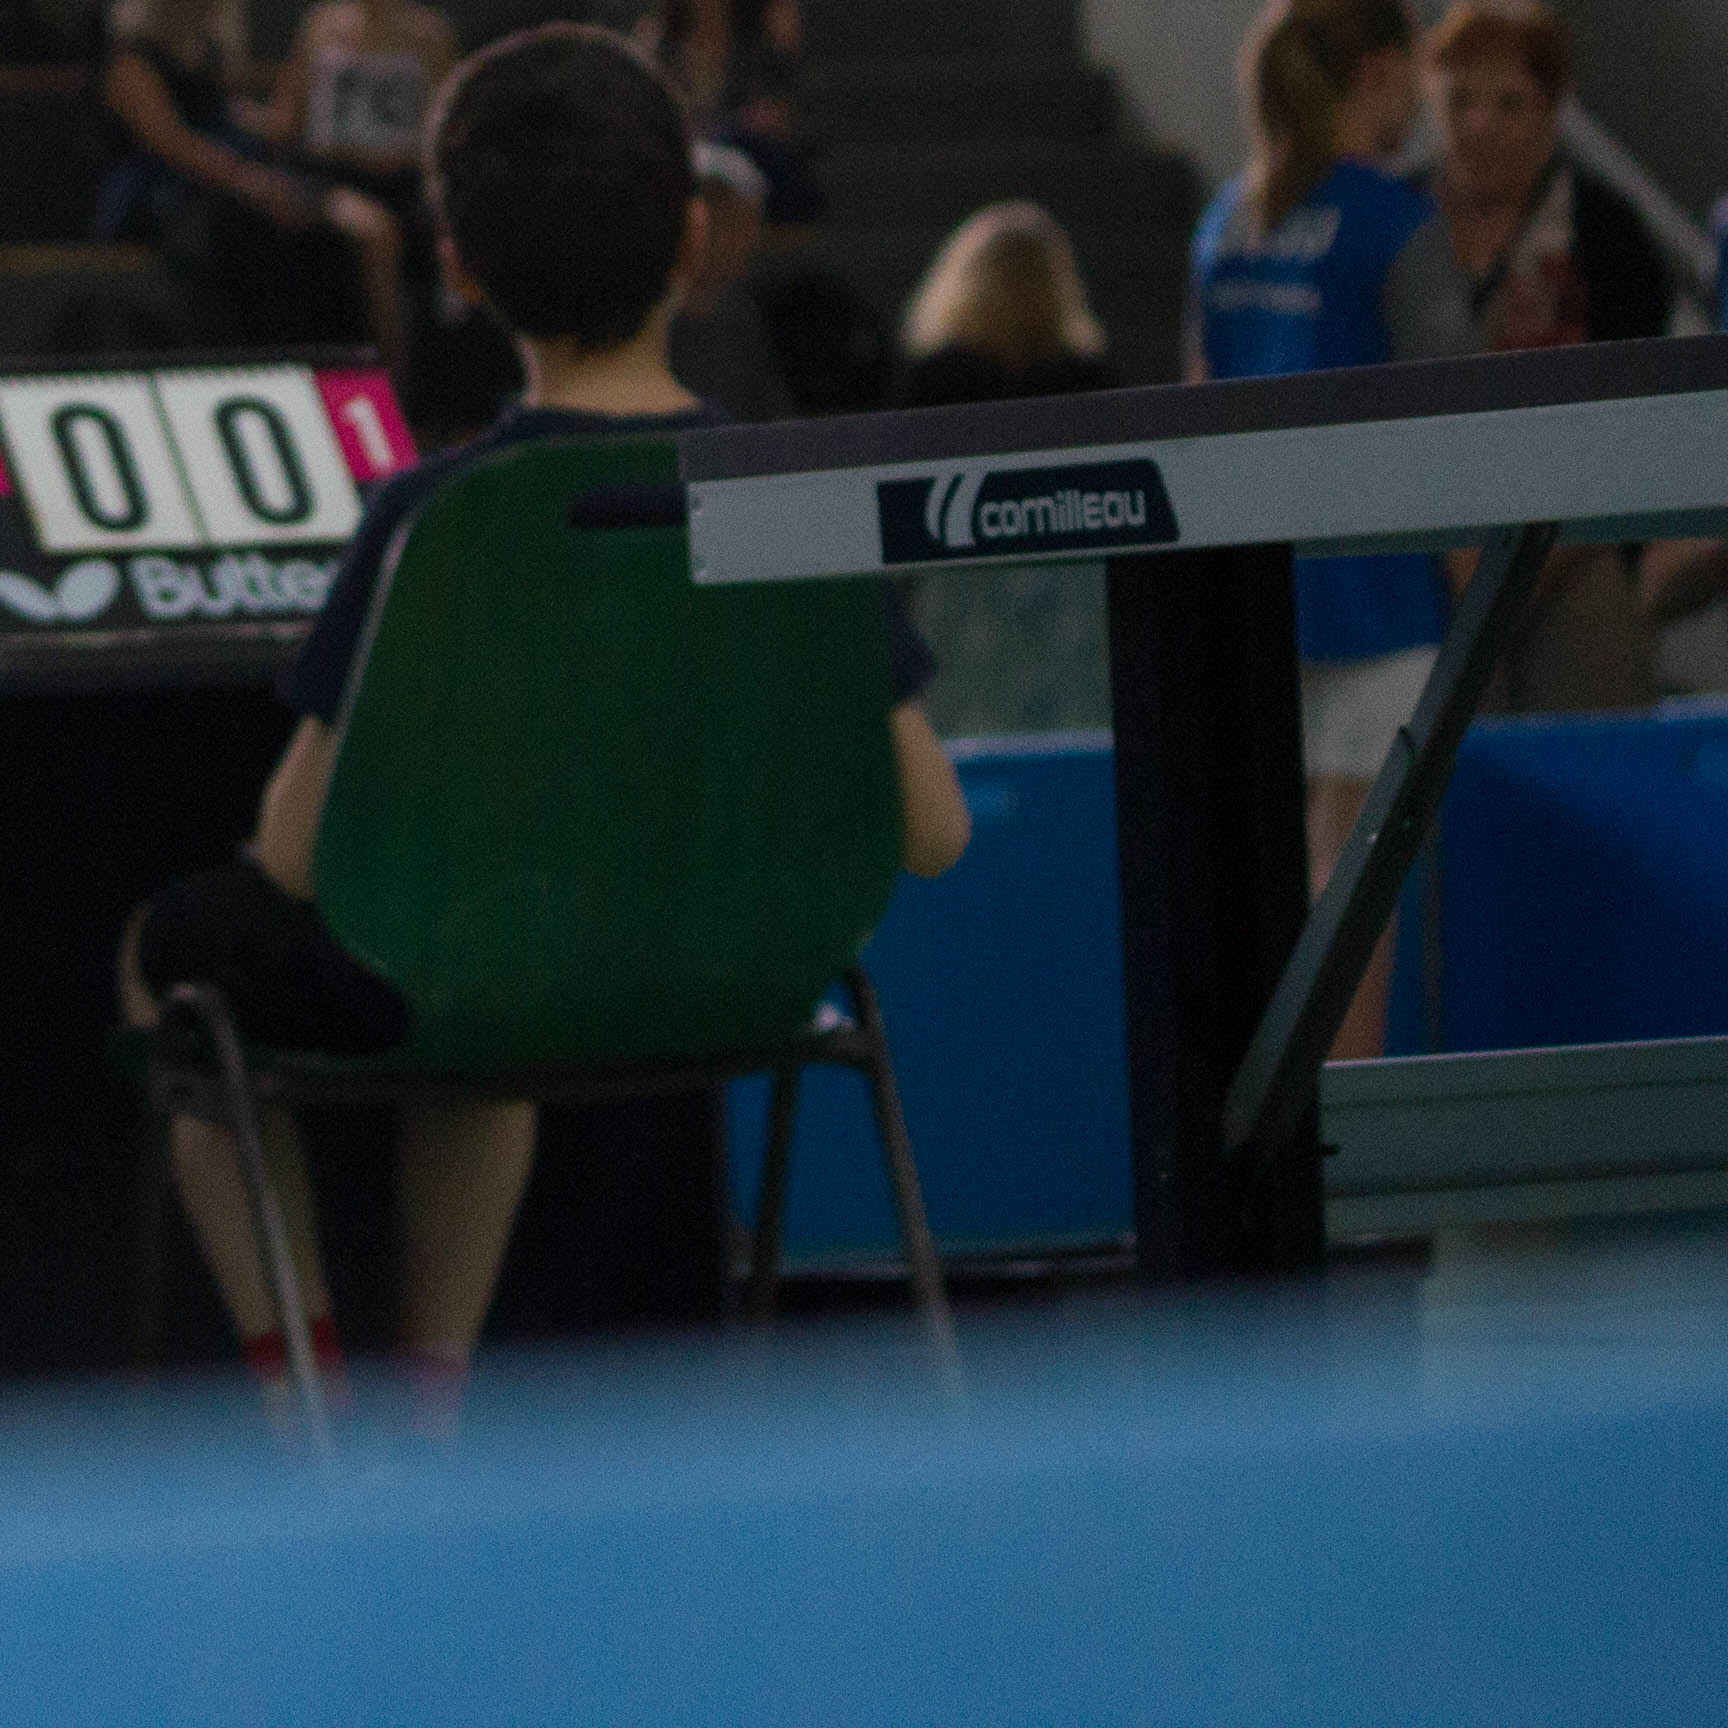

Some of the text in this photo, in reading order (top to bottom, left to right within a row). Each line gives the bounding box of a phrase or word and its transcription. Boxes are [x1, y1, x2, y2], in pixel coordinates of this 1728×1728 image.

[49, 400, 150, 532] 0
[211, 394, 317, 525] 0
[341, 394, 396, 470] 1
[129, 551, 341, 621] Butte
